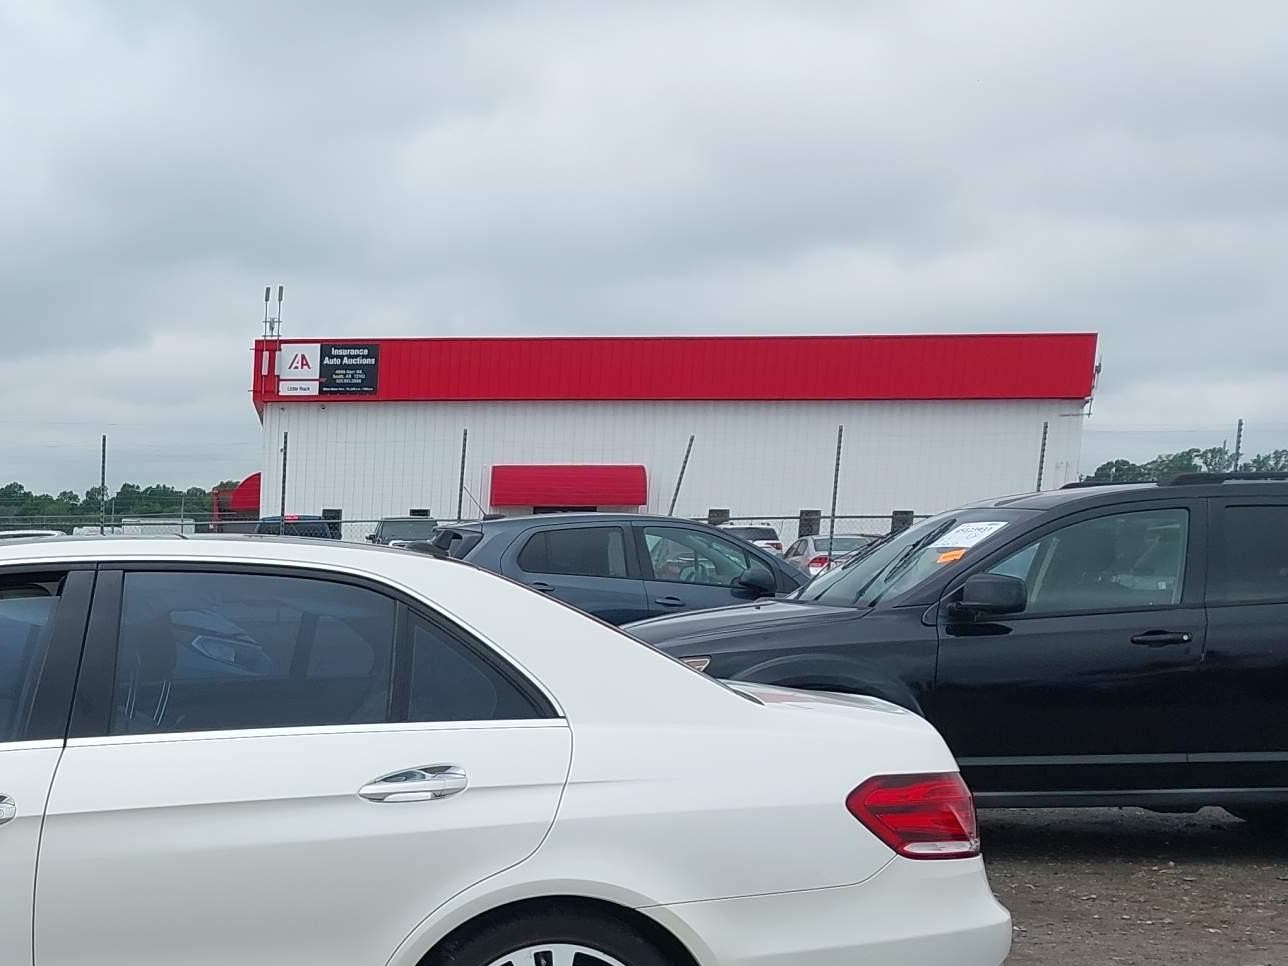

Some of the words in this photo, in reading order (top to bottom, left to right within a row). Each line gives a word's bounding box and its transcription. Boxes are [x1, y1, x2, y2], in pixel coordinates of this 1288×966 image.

[331, 347, 369, 355] Insurance
[323, 356, 341, 365] Auto
[342, 356, 376, 365] Auctions
